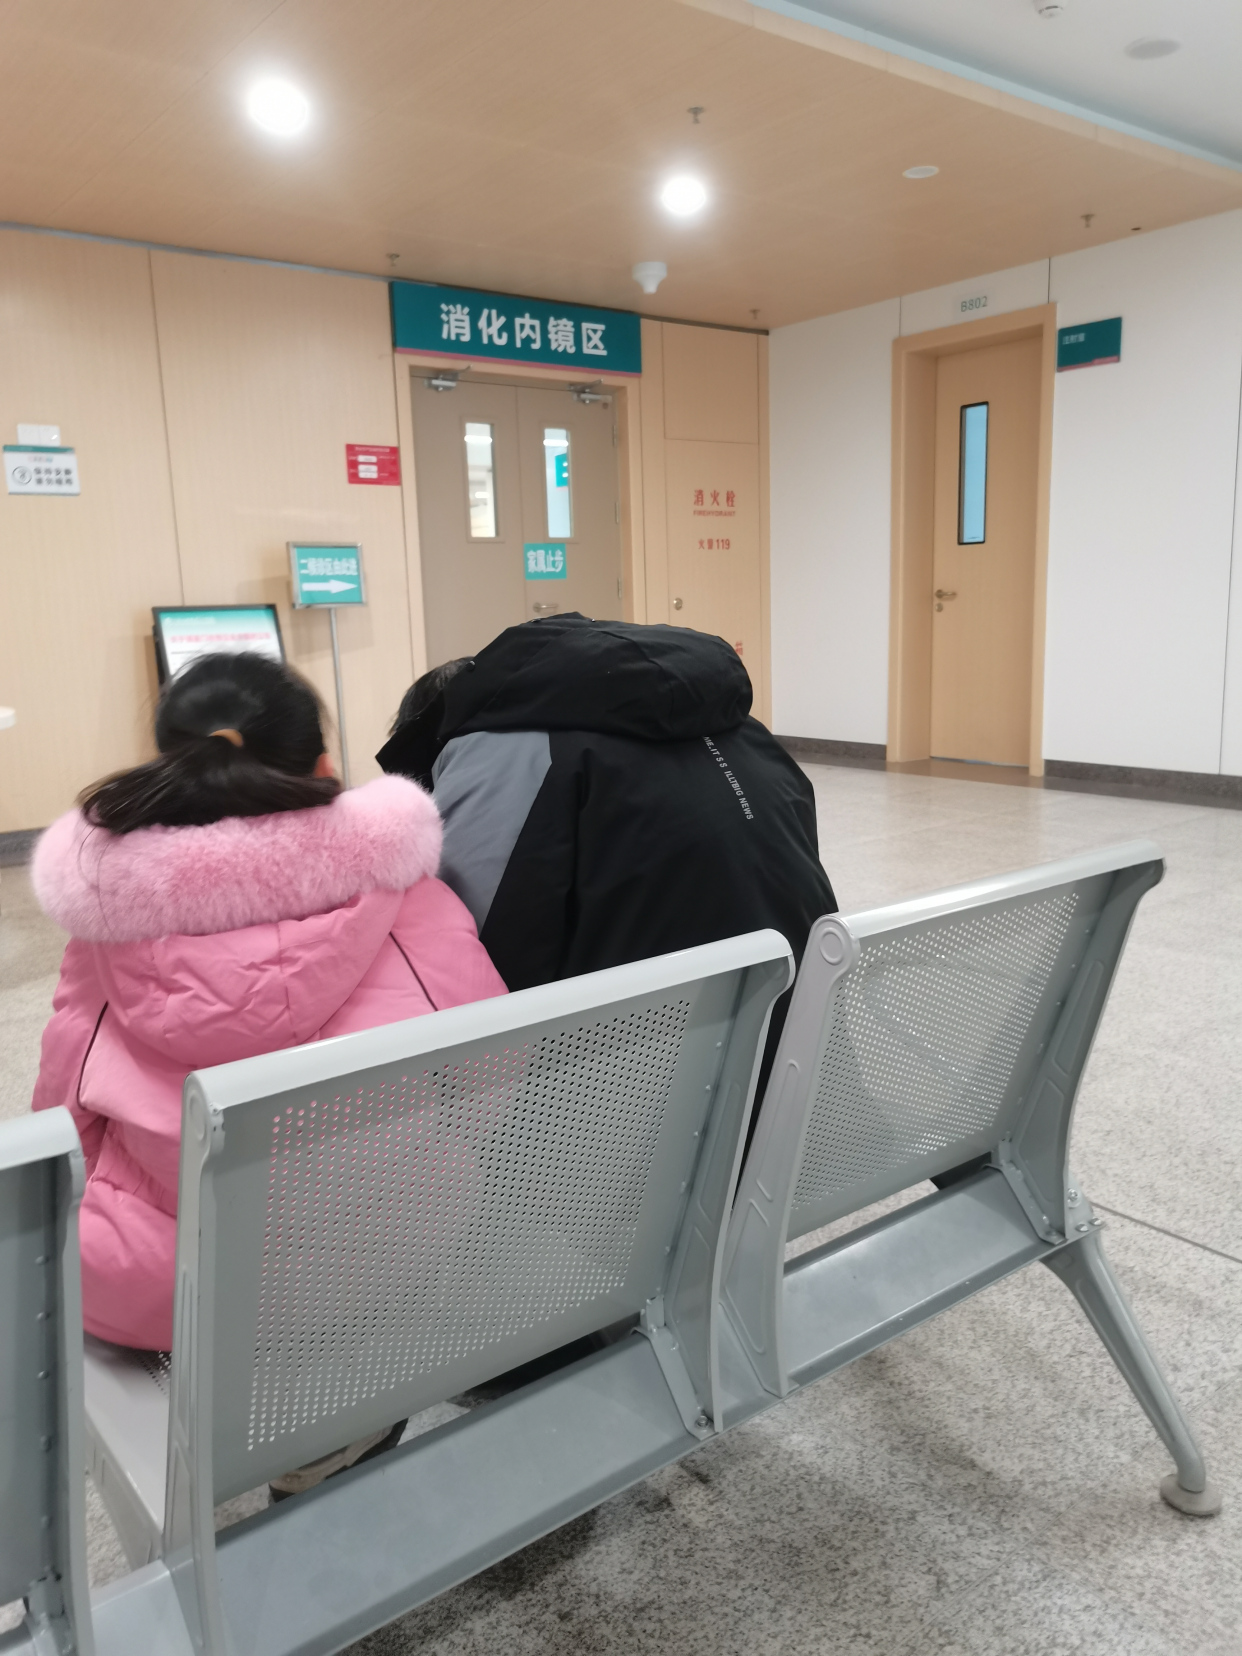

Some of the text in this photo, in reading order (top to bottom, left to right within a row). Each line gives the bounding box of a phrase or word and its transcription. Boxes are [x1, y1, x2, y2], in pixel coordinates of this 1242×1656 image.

[960, 295, 988, 312] B802
[439, 303, 608, 357] 消化内镜区
[694, 489, 735, 507] 消火栓
[526, 549, 564, 573] 家属止步
[739, 797, 754, 820] NEWS
